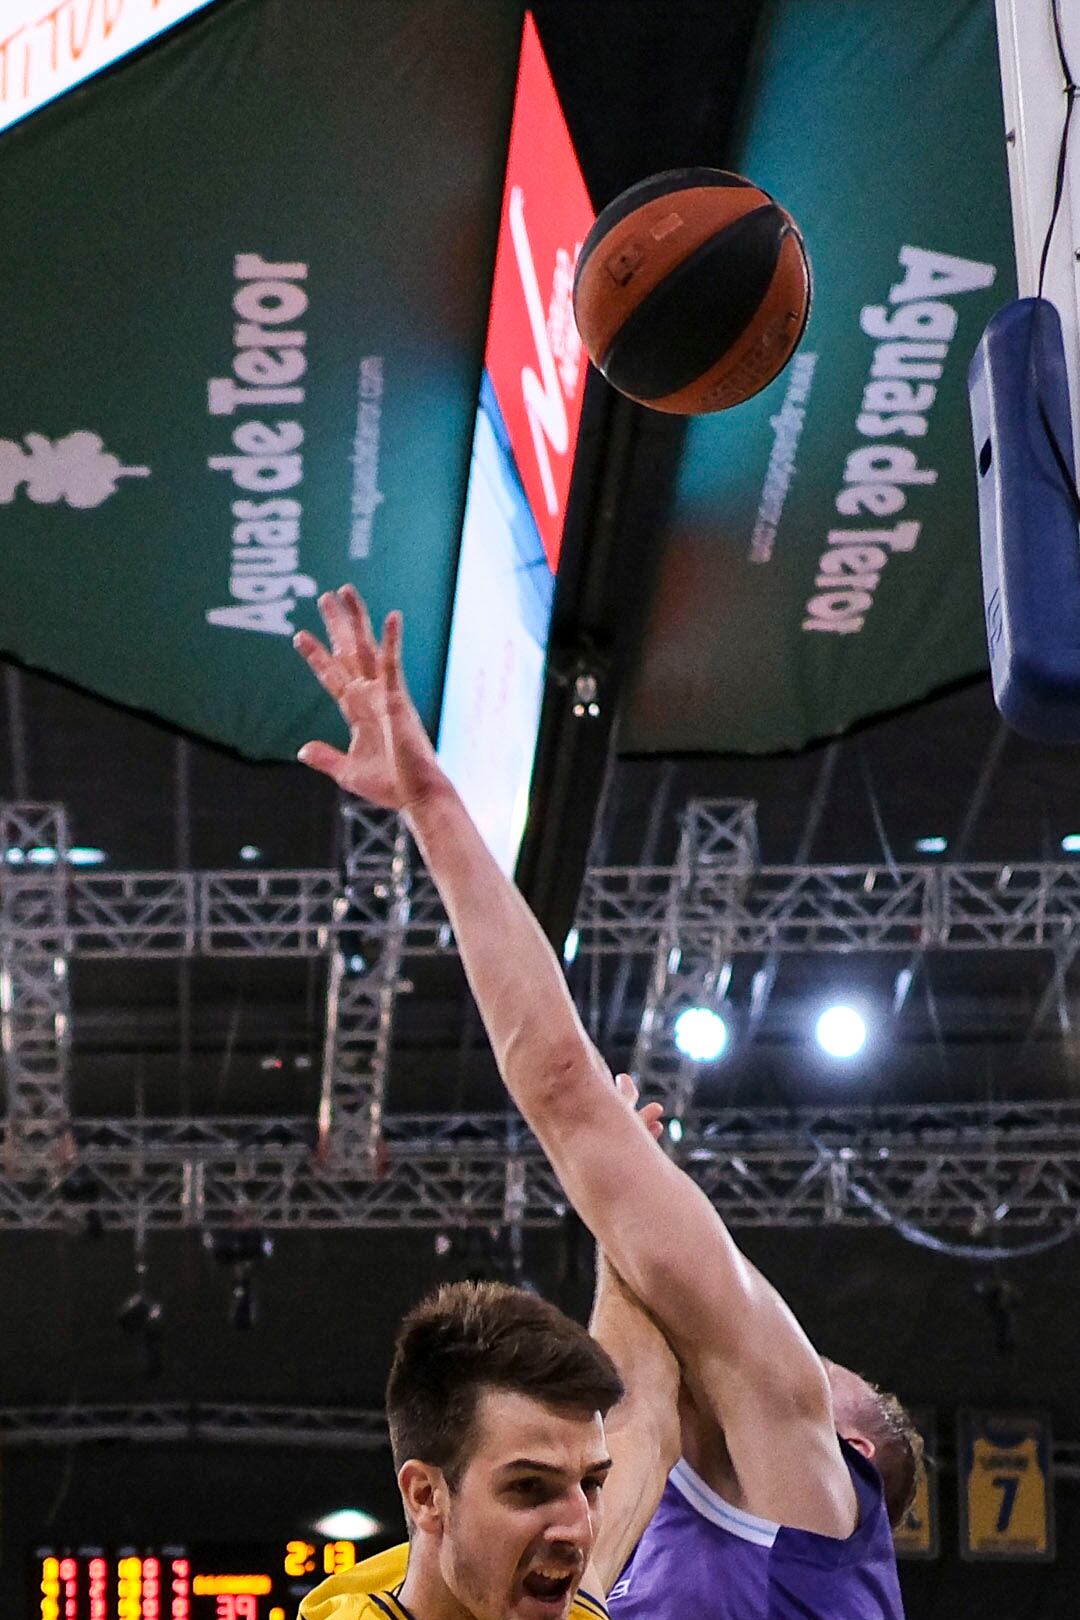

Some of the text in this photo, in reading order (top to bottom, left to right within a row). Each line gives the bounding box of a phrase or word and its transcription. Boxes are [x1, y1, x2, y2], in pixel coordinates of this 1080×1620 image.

[205, 253, 318, 636] Aguas de Teror
[801, 245, 997, 634] Aguas de Teror
[992, 1477, 1020, 1532] 7
